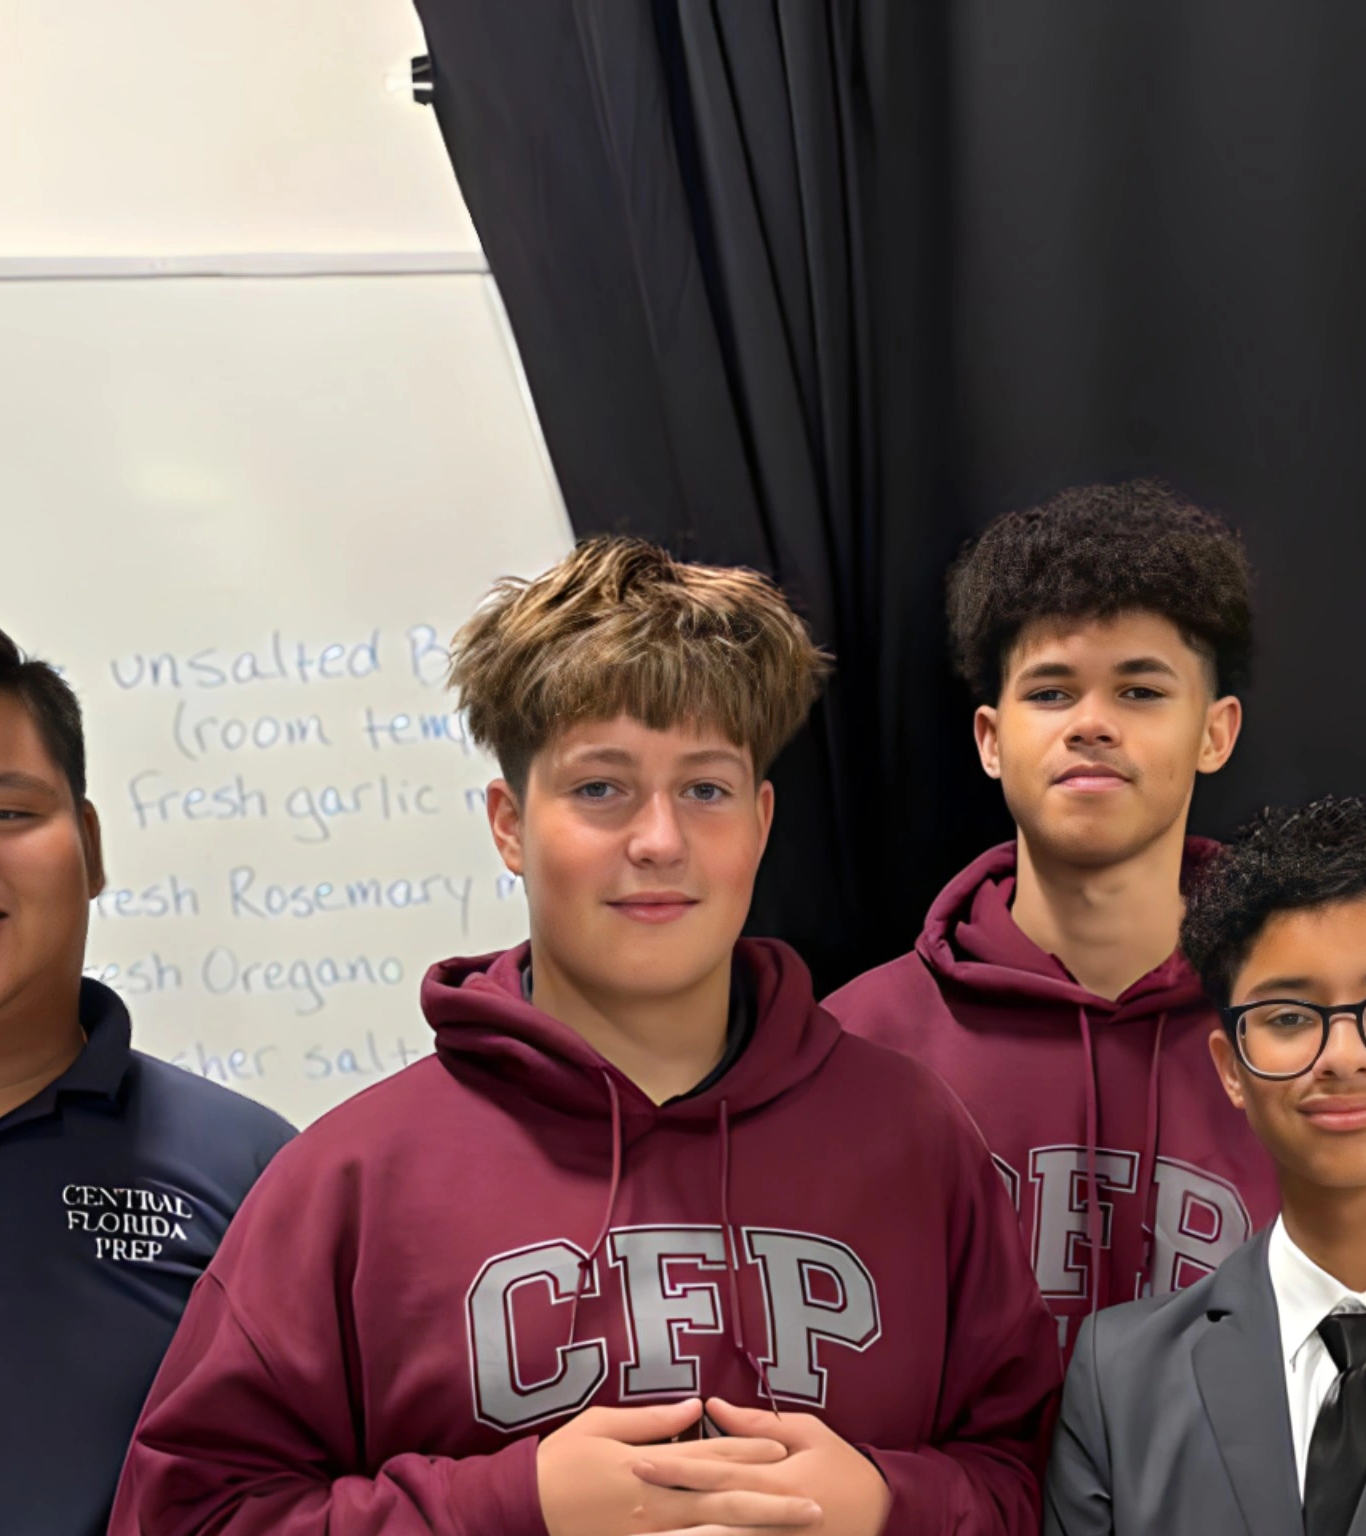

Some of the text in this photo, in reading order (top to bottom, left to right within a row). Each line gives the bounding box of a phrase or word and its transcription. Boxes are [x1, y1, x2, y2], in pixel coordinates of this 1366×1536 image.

[110, 622, 451, 691] unsalted B
[172, 700, 332, 763] (room
[285, 775, 440, 843] garlic
[97, 873, 200, 920] resh
[229, 865, 473, 935] Rosemary
[201, 944, 405, 1016] Oregano
[302, 1030, 420, 1080] salt
[62, 1184, 193, 1219] CENTRAL
[66, 1210, 188, 1241] FLORIDA
[95, 1237, 162, 1262] PREP
[465, 1224, 882, 1433] CFP
